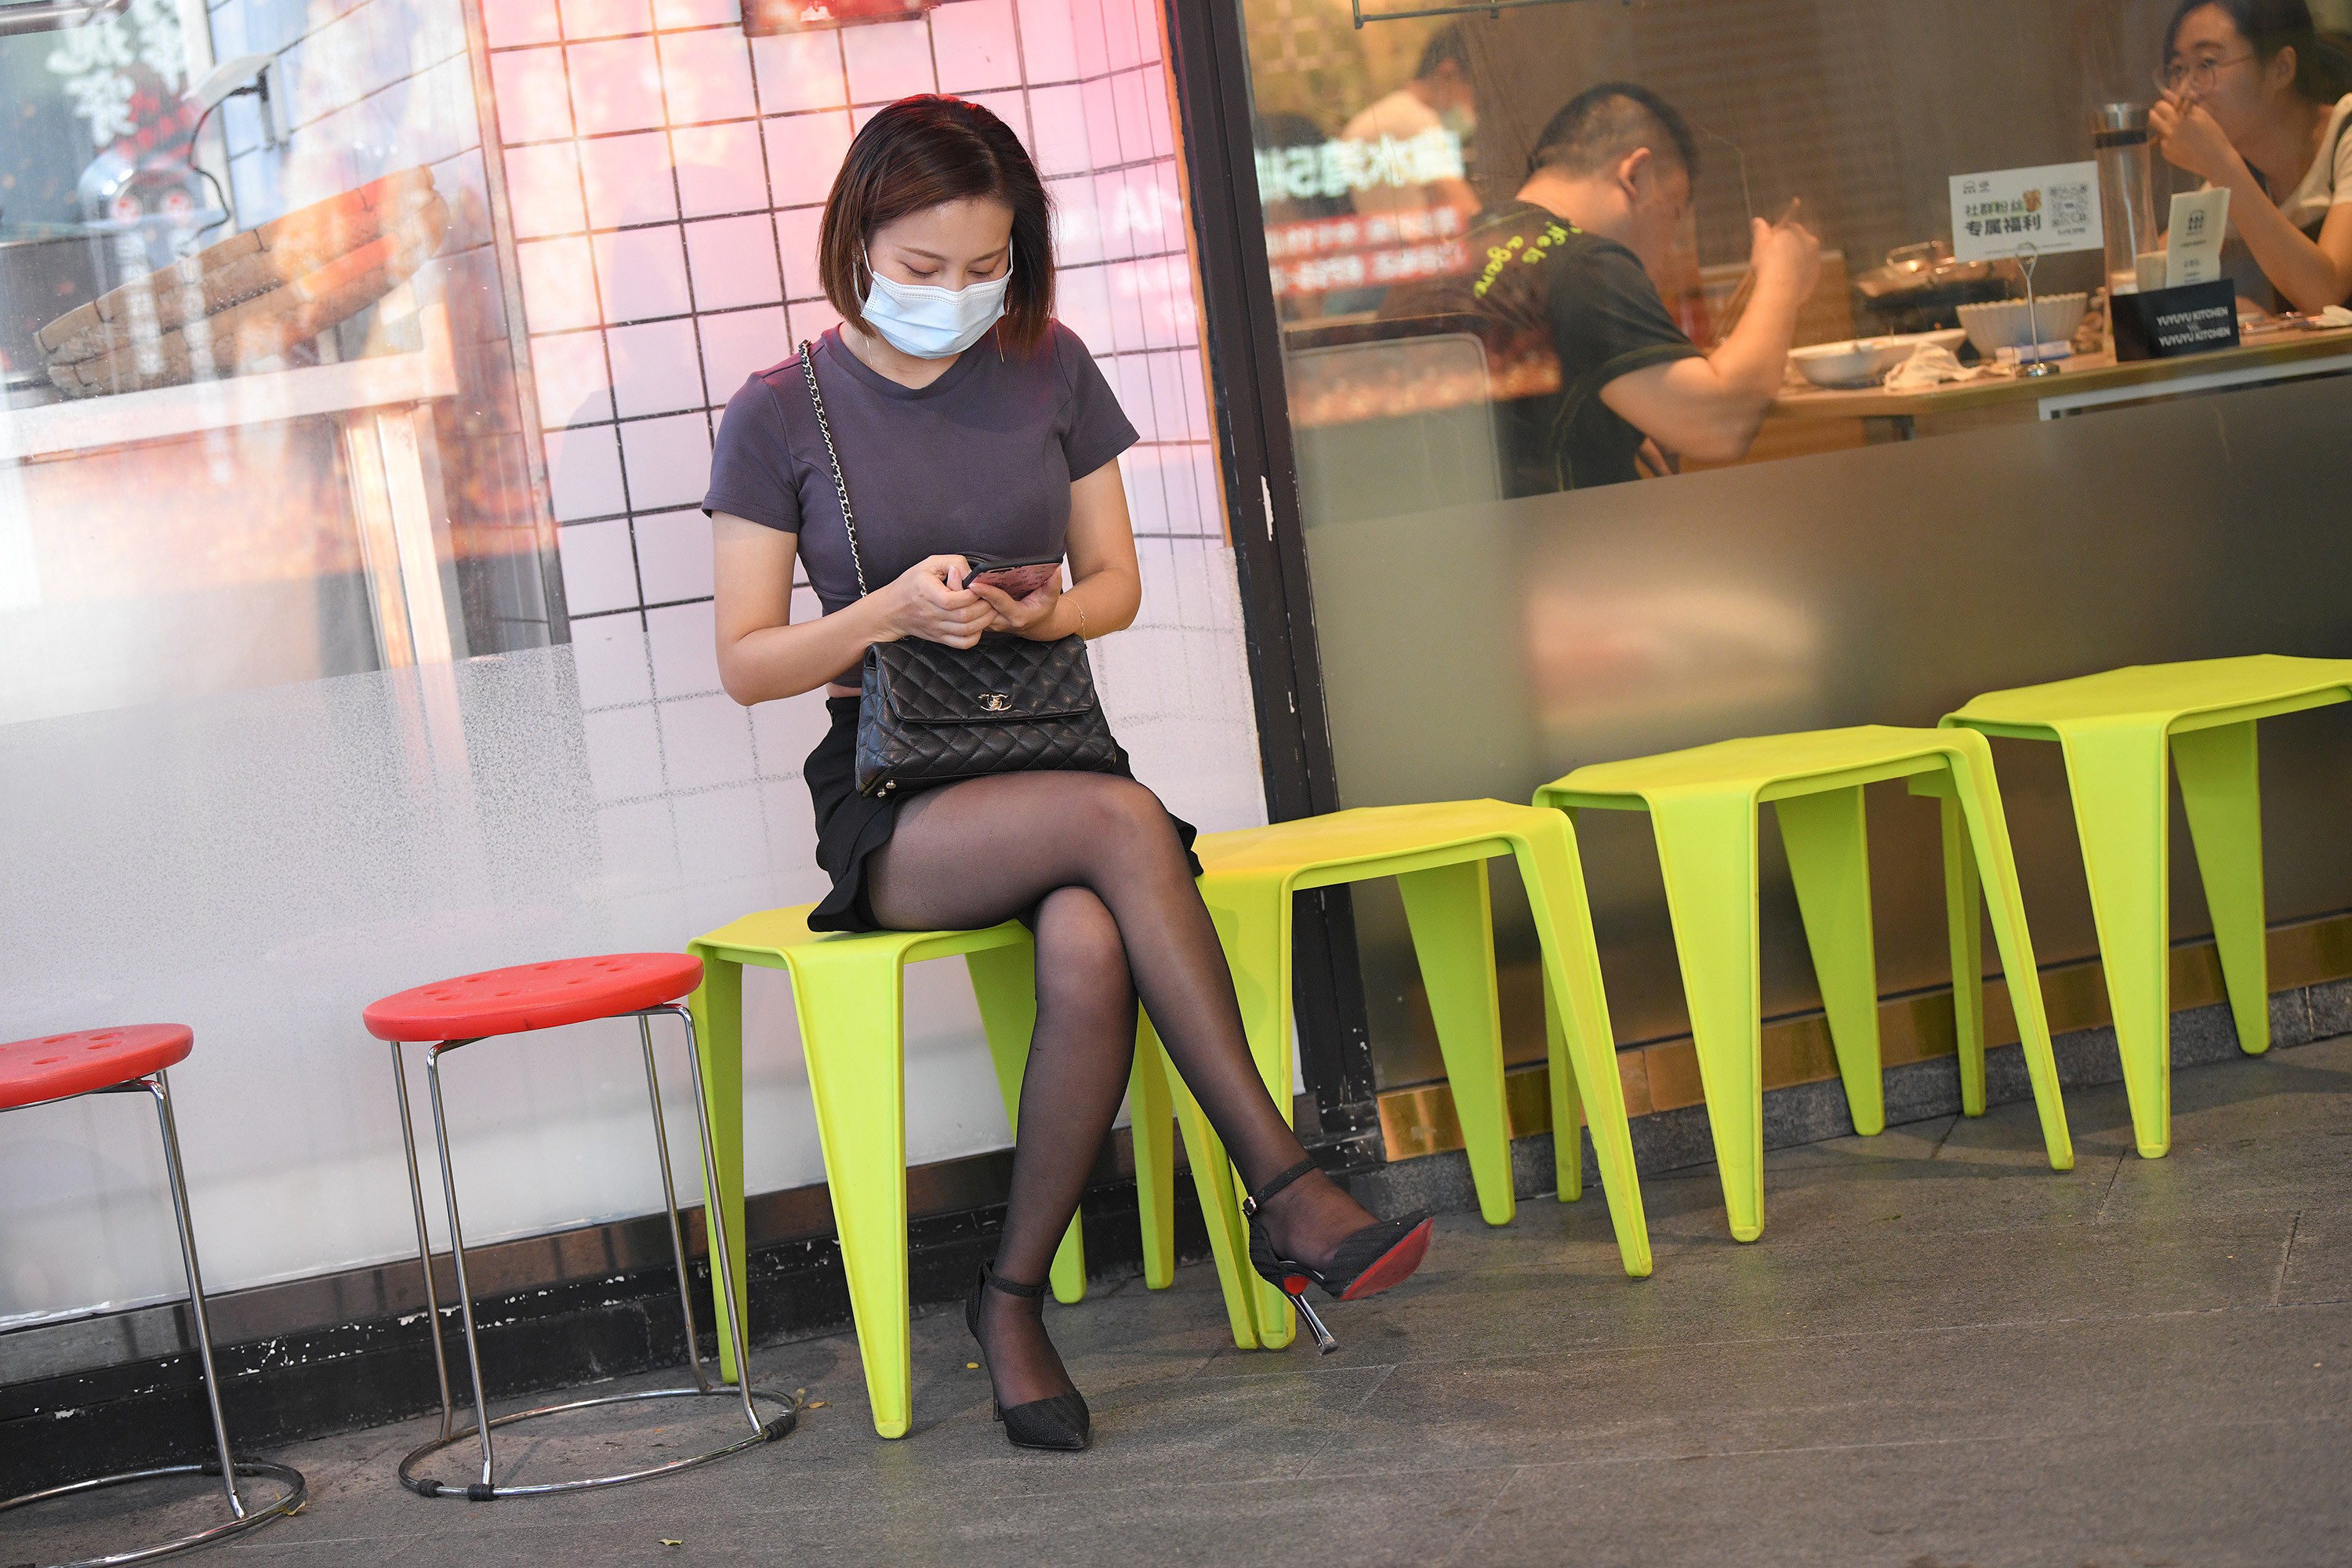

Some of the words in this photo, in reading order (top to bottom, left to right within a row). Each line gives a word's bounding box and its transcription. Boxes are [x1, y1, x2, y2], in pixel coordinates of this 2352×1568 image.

[1965, 198, 2025, 217] 社群粉丝
[1965, 213, 2042, 237] 专属福利
[2192, 305, 2229, 322] KITCHEN
[2194, 326, 2231, 342] KITCHEN
